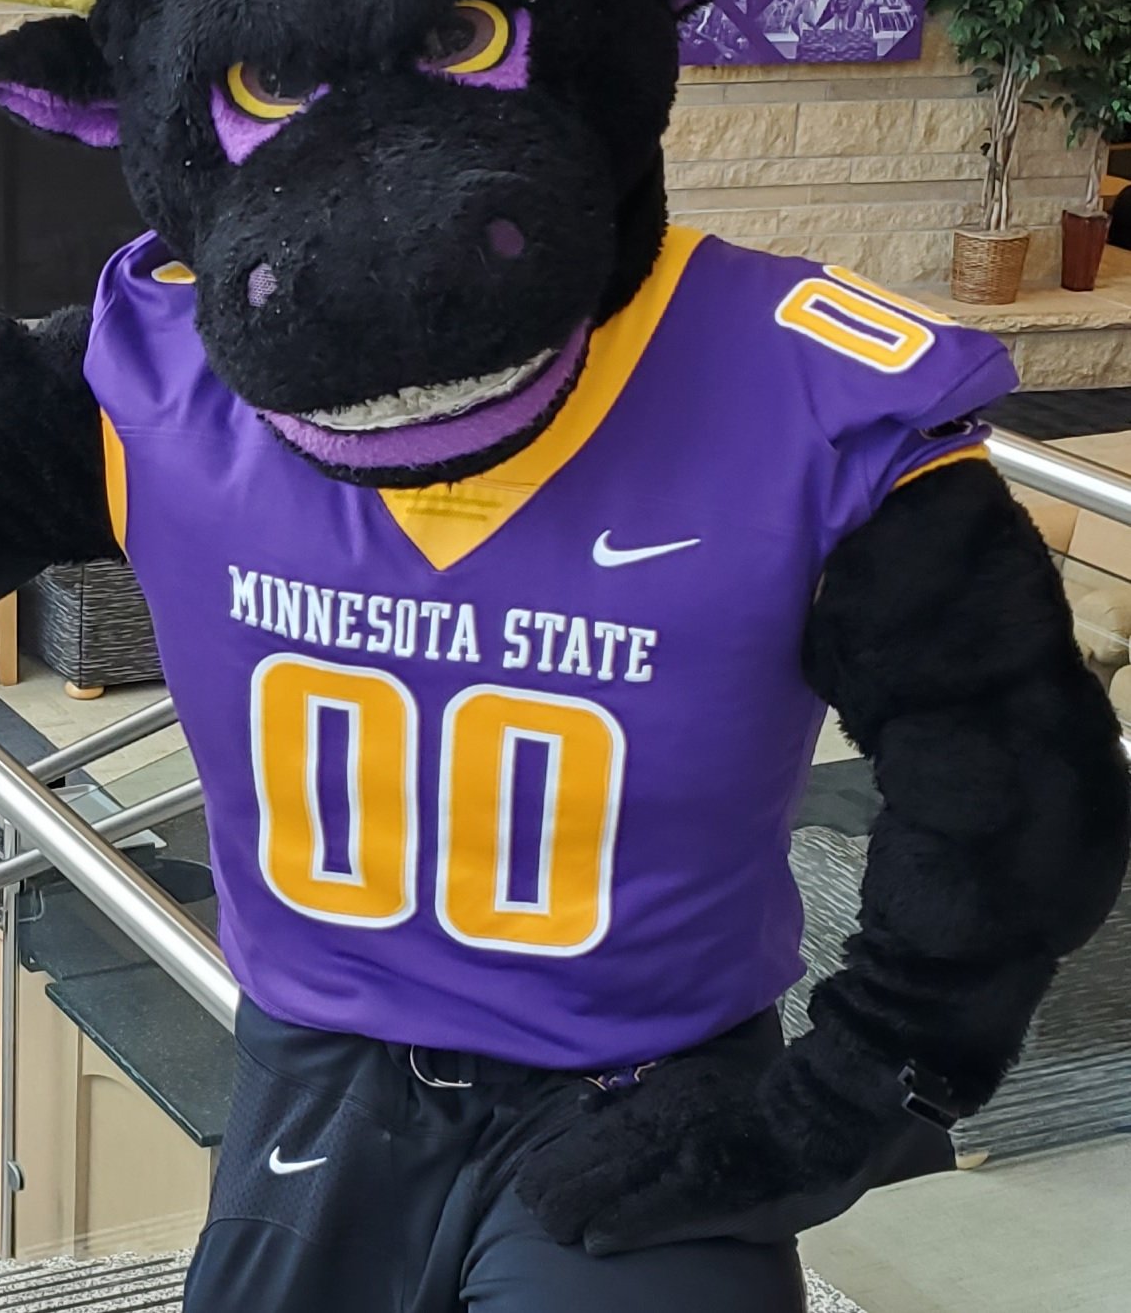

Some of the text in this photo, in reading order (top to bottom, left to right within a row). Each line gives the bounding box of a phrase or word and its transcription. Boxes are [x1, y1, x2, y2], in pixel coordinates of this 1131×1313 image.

[229, 564, 658, 682] MINNESOTA STATE
[251, 652, 626, 957] 00
